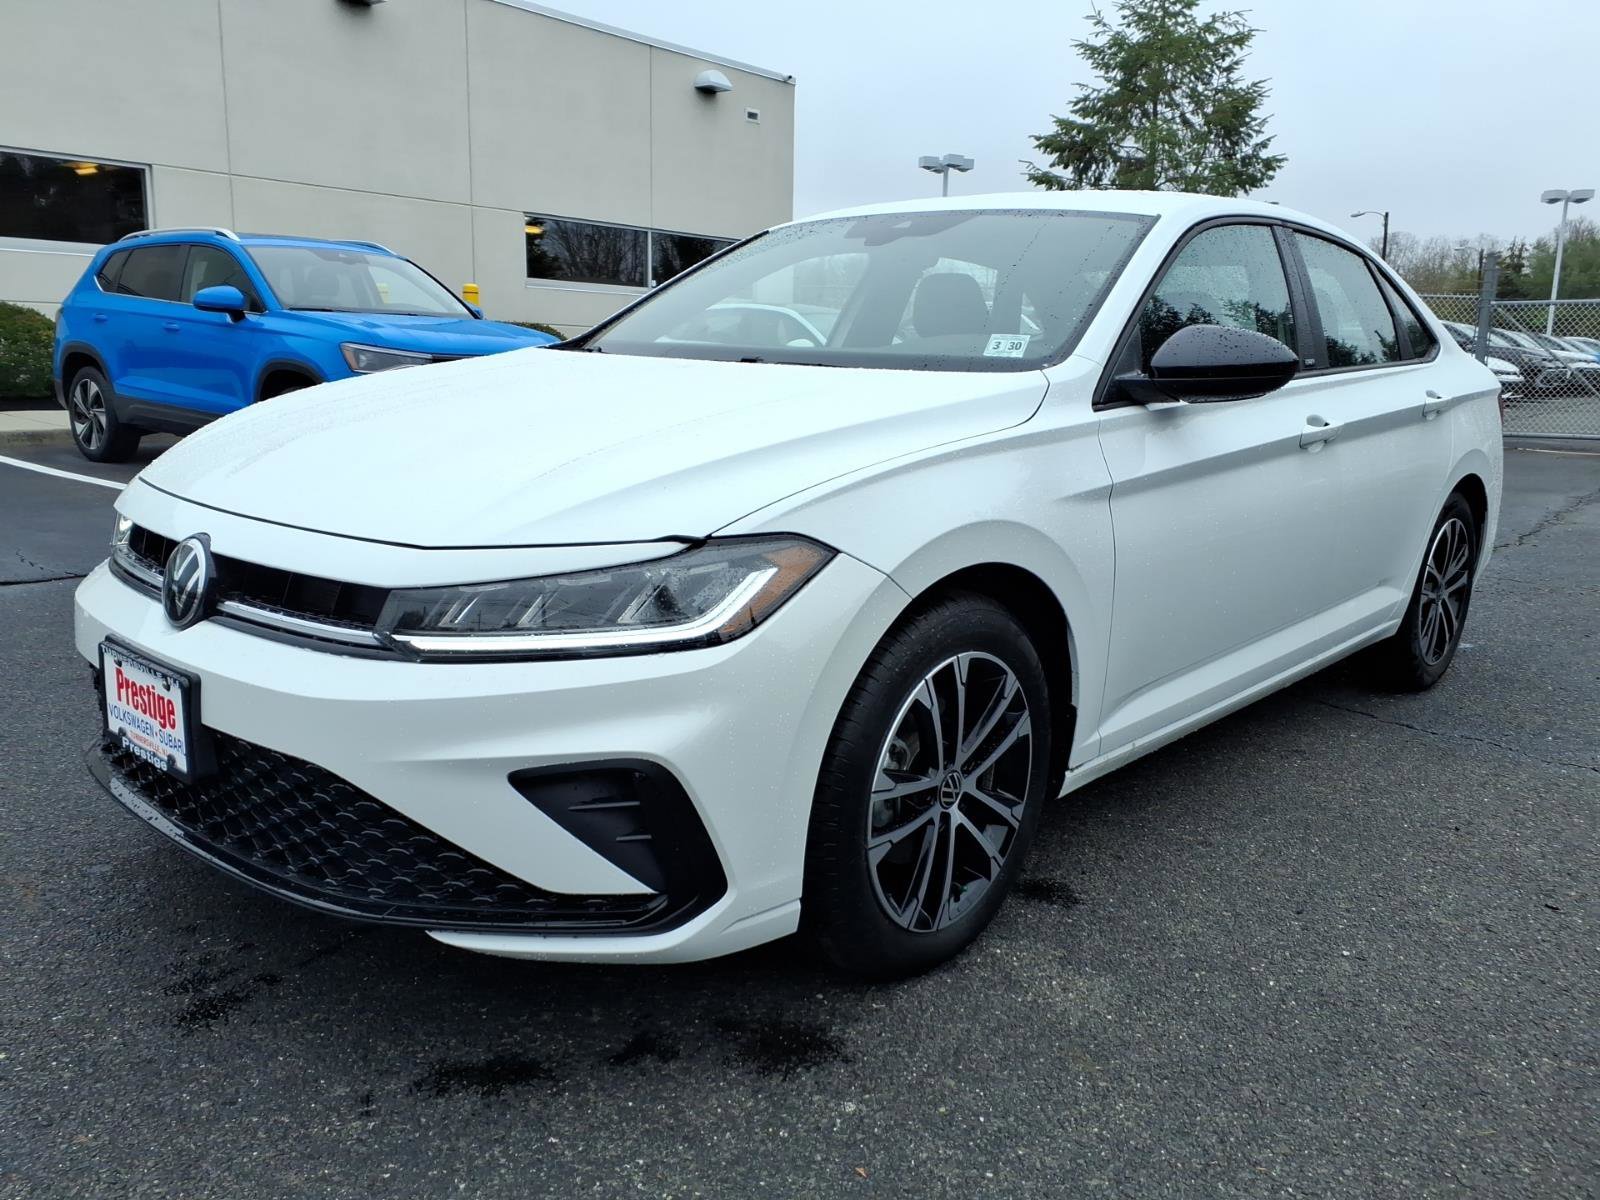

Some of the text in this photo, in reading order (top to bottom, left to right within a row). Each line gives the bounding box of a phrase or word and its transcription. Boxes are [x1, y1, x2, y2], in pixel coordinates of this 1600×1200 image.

[992, 341, 1023, 351] 3 30
[115, 666, 177, 730] Prestige
[108, 703, 155, 738] VOLKSWAGEN
[121, 736, 169, 772] Prestige
